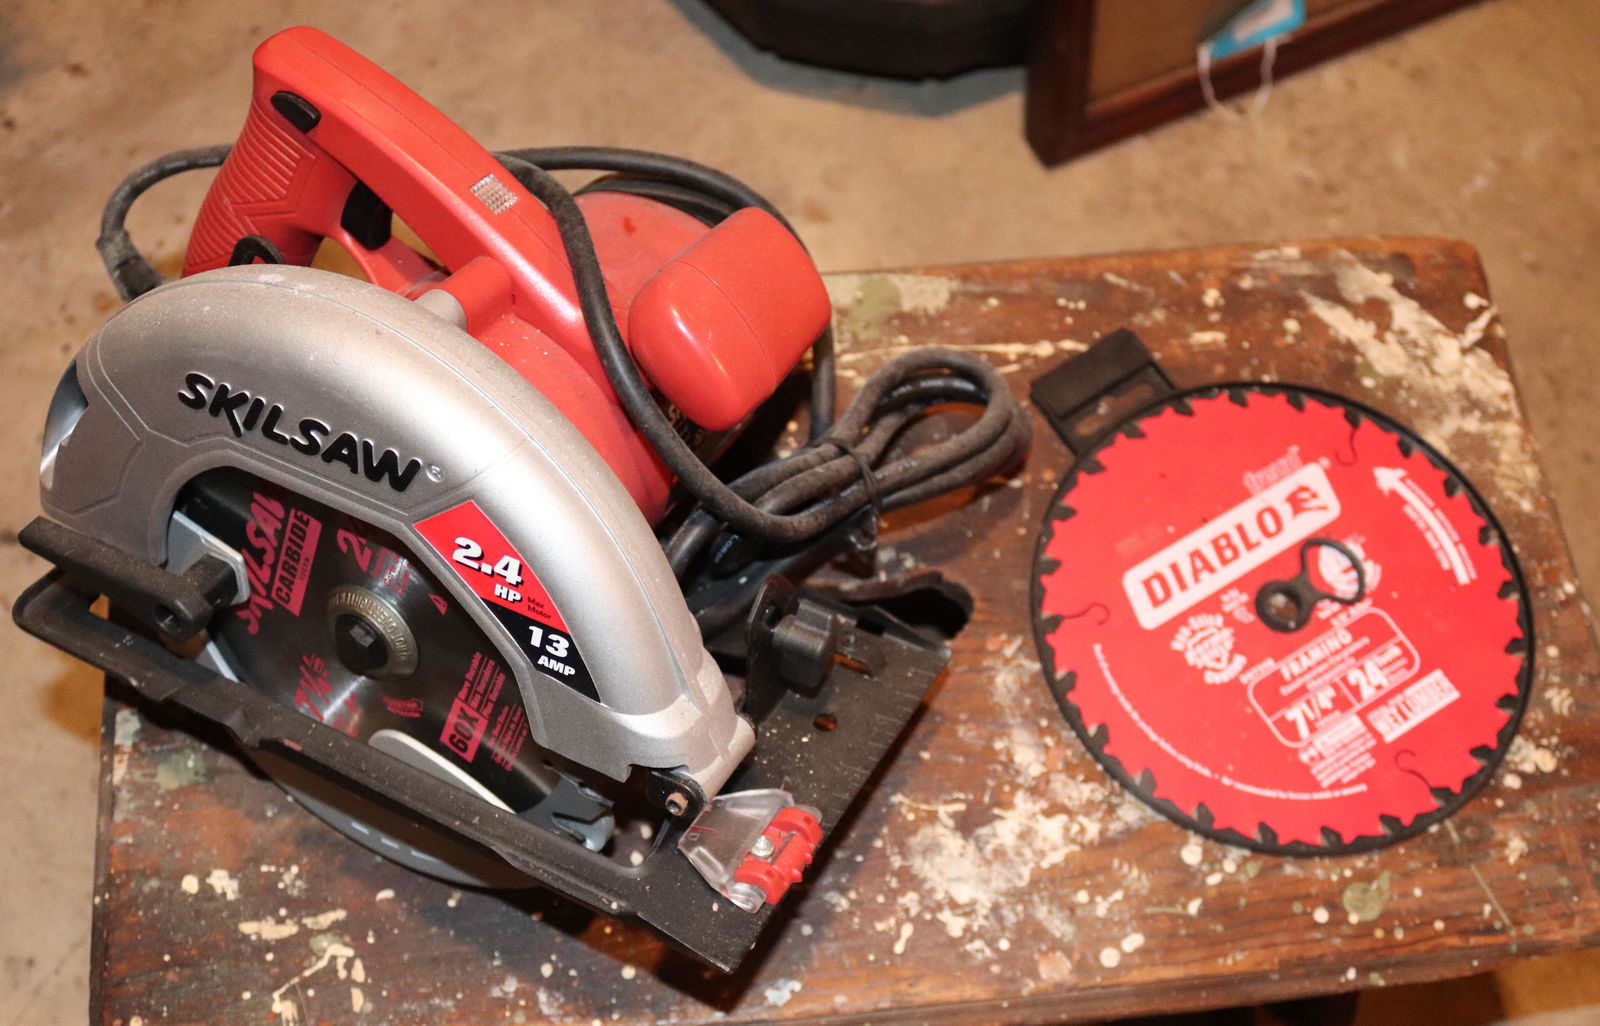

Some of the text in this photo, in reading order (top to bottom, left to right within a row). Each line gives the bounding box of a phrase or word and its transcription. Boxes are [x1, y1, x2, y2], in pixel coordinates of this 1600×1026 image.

[178, 371, 421, 492] SKILSAW
[274, 510, 311, 605] CARBIDE
[452, 537, 524, 587] 2.4
[1142, 505, 1283, 608] DIABLO
[494, 584, 522, 603] HP
[527, 596, 545, 609] Max
[527, 605, 552, 620] Motor
[529, 625, 570, 658] 13
[1280, 627, 1352, 681] FRAMING
[537, 655, 576, 676] AMP
[1347, 659, 1389, 700] 24
[449, 706, 480, 754] 60X
